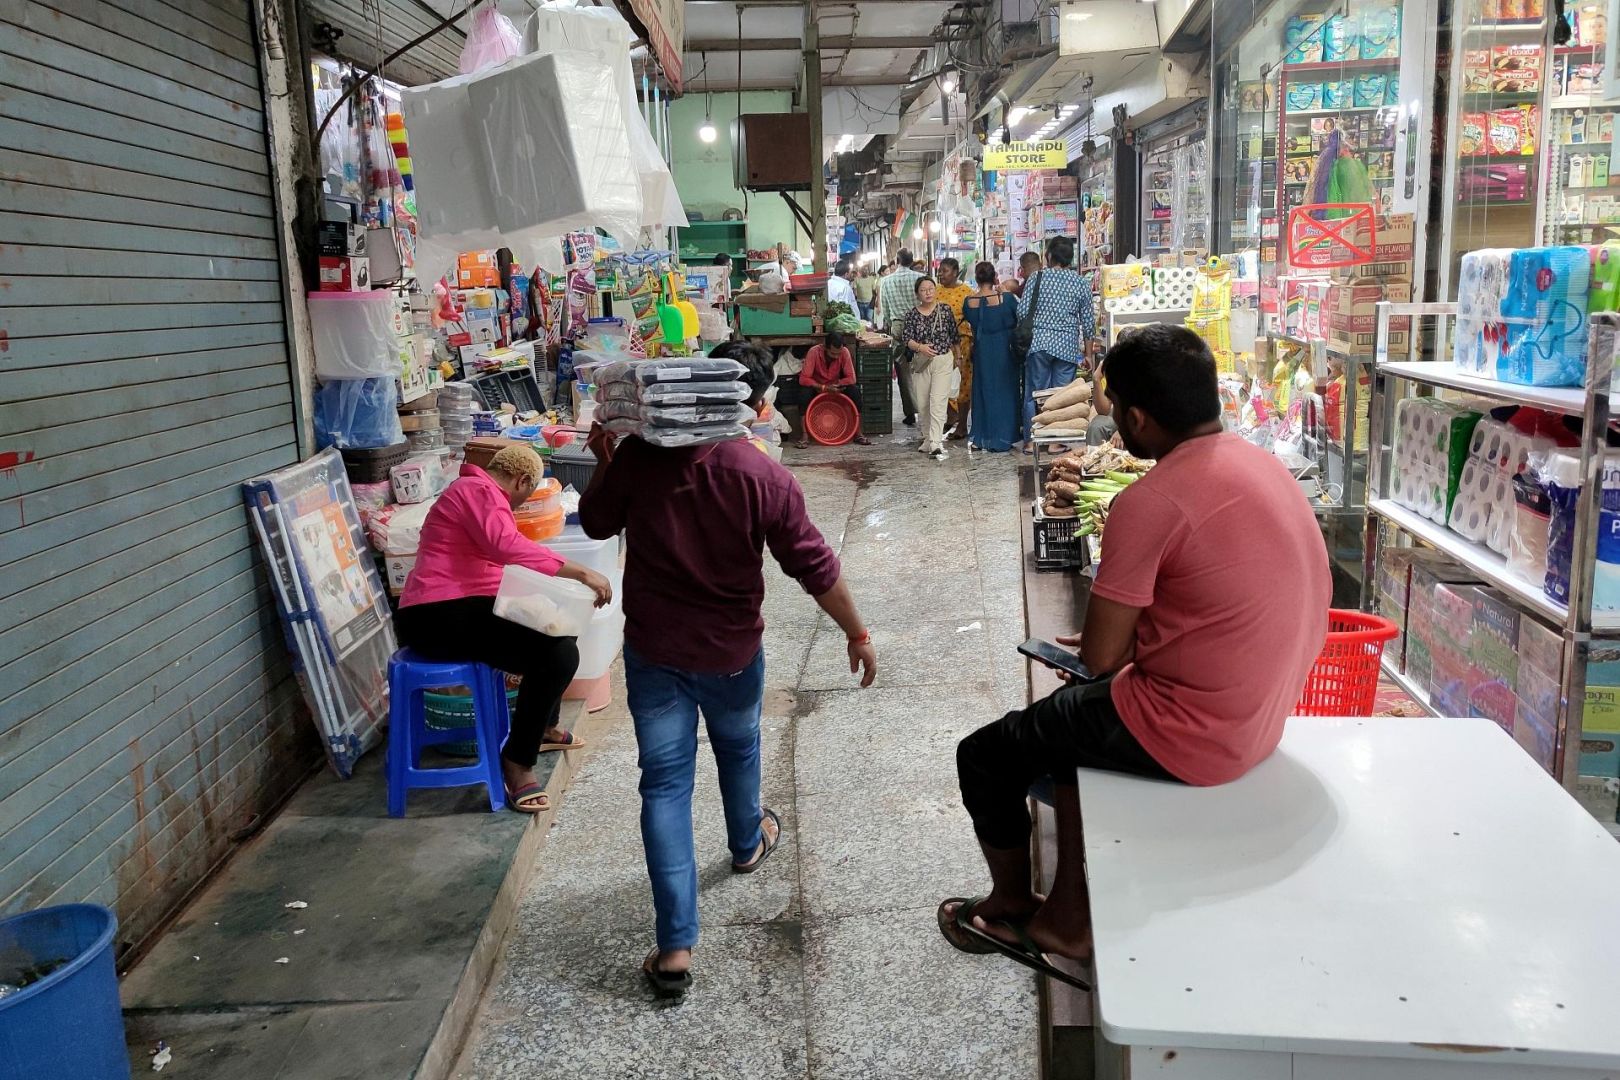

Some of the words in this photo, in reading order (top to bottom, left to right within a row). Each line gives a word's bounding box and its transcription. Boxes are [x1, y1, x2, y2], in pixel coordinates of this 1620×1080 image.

[989, 142, 1063, 153] TAMILNADU
[1006, 154, 1046, 164] STORE
[1384, 244, 1411, 253] FLAVOUR
[1352, 315, 1375, 325] CHICKE
[1482, 602, 1515, 629] Natural
